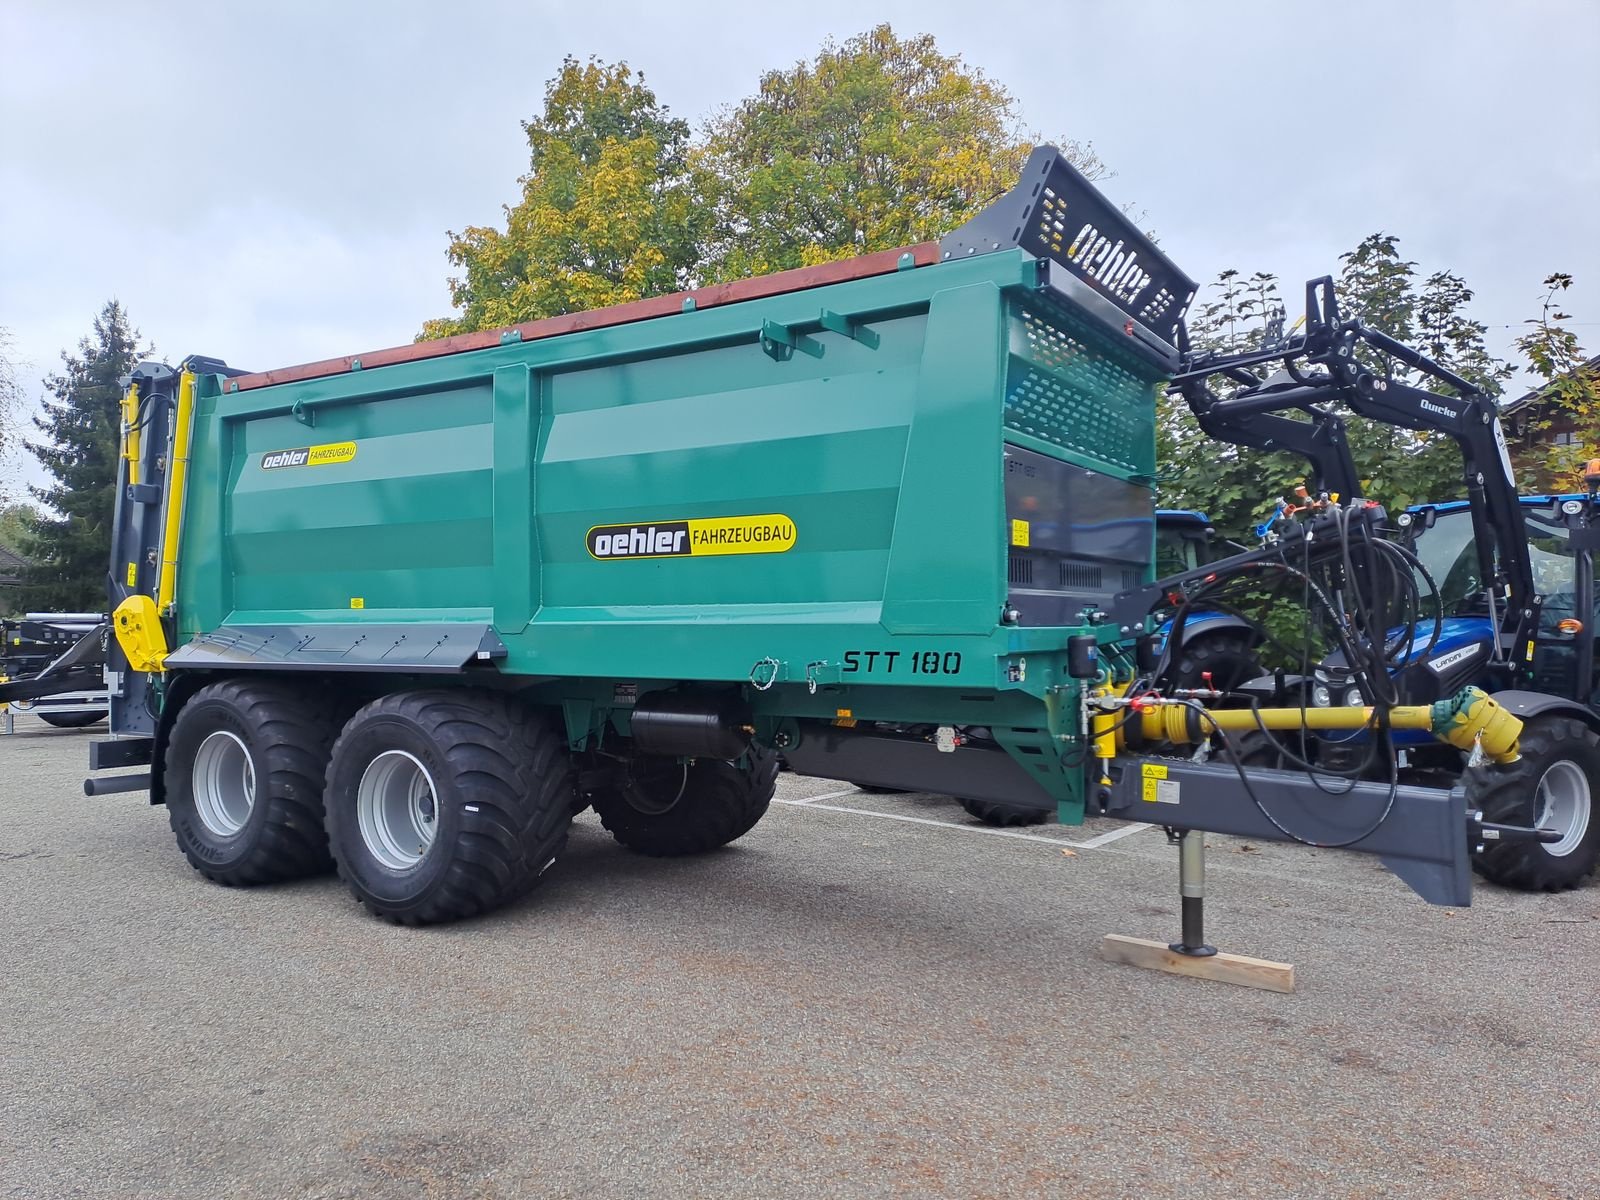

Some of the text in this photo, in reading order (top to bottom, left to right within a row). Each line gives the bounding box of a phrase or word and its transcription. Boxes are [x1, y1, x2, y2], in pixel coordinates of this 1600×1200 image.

[1067, 223, 1152, 305] oehler
[1420, 399, 1457, 419] Quicke
[263, 446, 356, 469] oehler FAHRZEUGBAU
[594, 524, 792, 556] oehler FAHRZEUGBAU
[842, 651, 962, 674] STT 180
[1435, 652, 1462, 669] LANDINI
